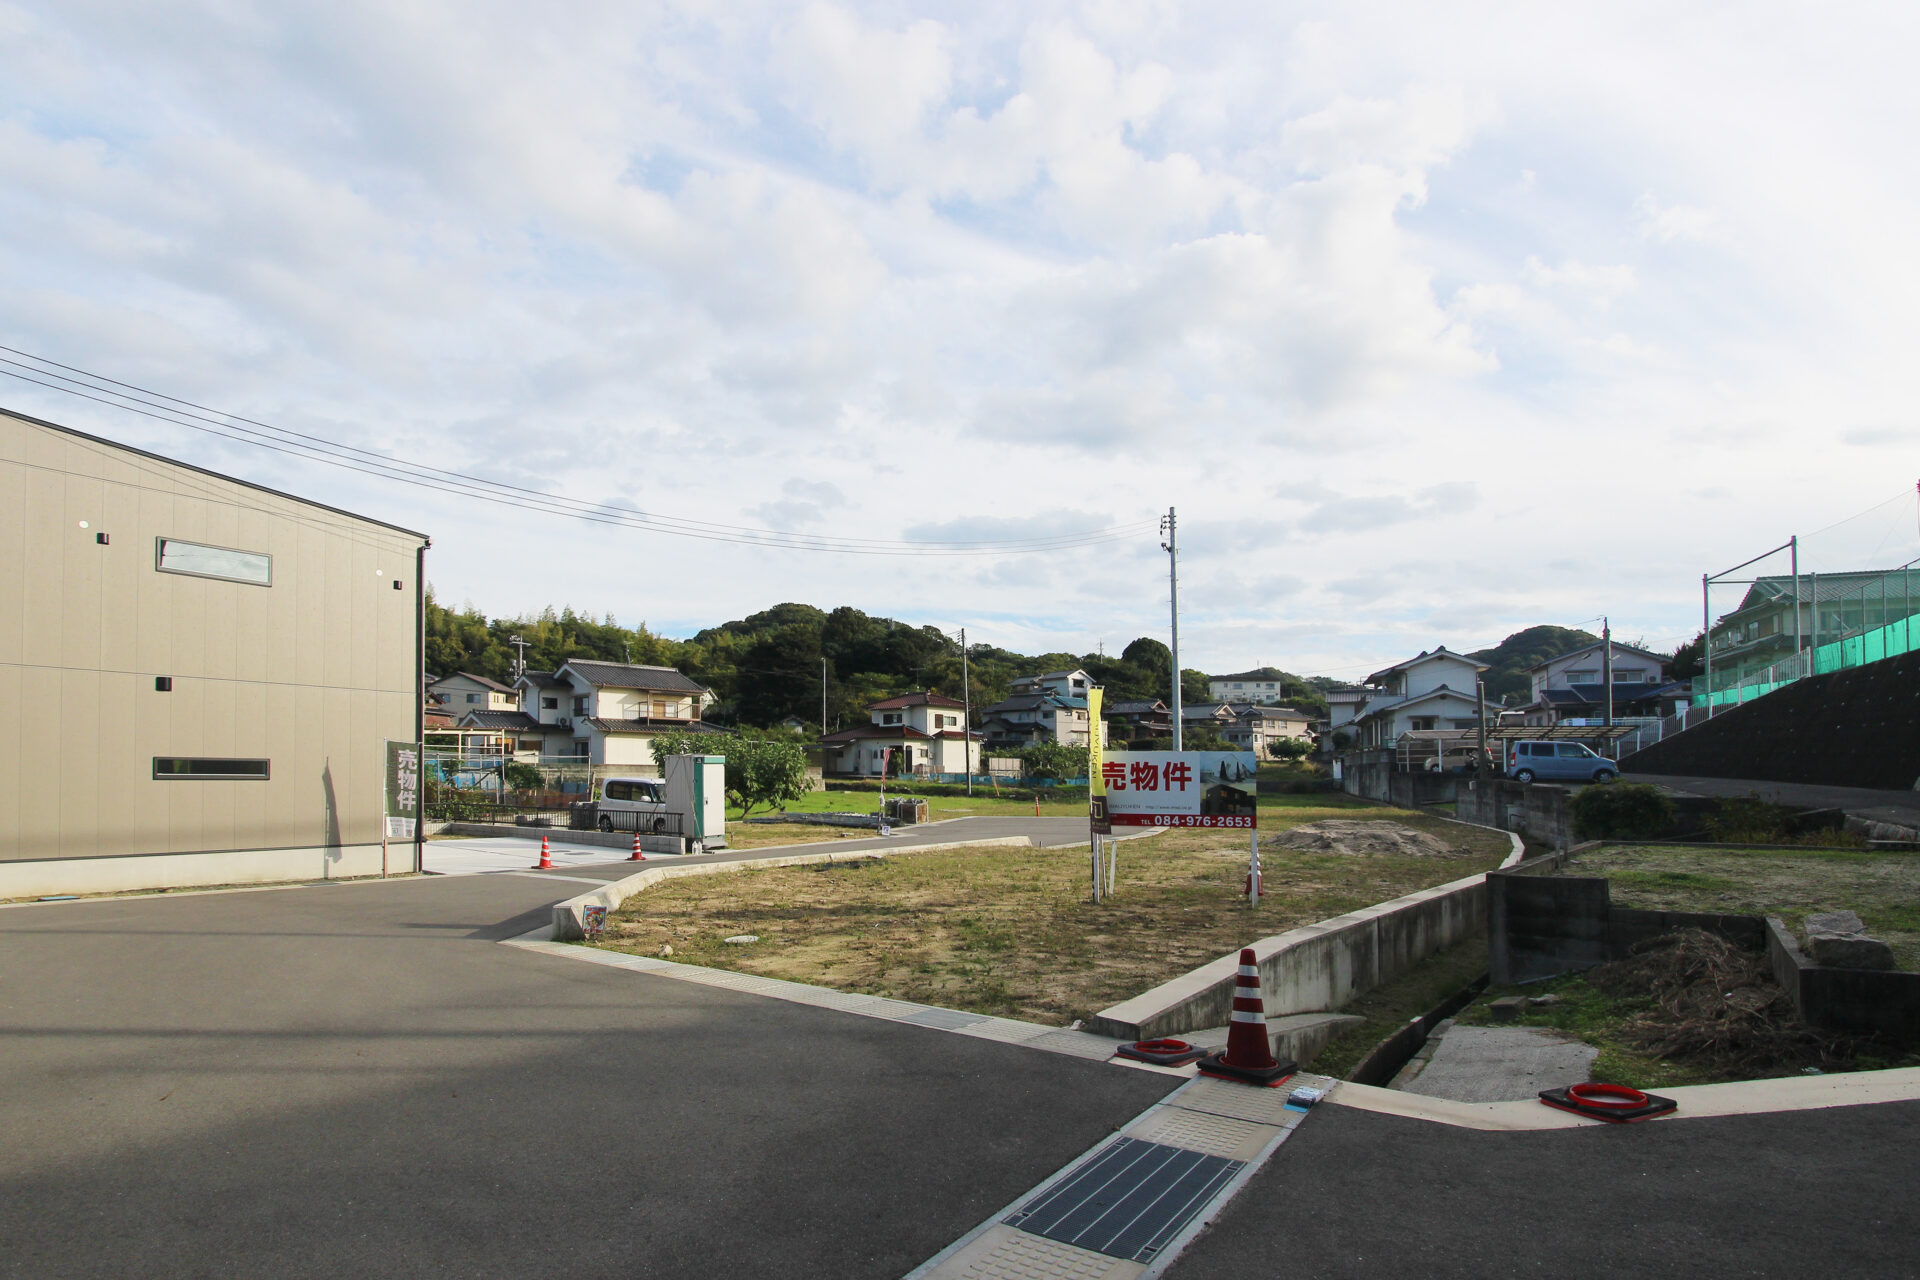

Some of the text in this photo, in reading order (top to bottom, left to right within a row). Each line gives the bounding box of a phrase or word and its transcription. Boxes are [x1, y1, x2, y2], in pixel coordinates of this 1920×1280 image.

[397, 749, 418, 811] 売物件
[1102, 761, 1192, 792] 売物件
[1154, 815, 1252, 827] 084-976-2653
